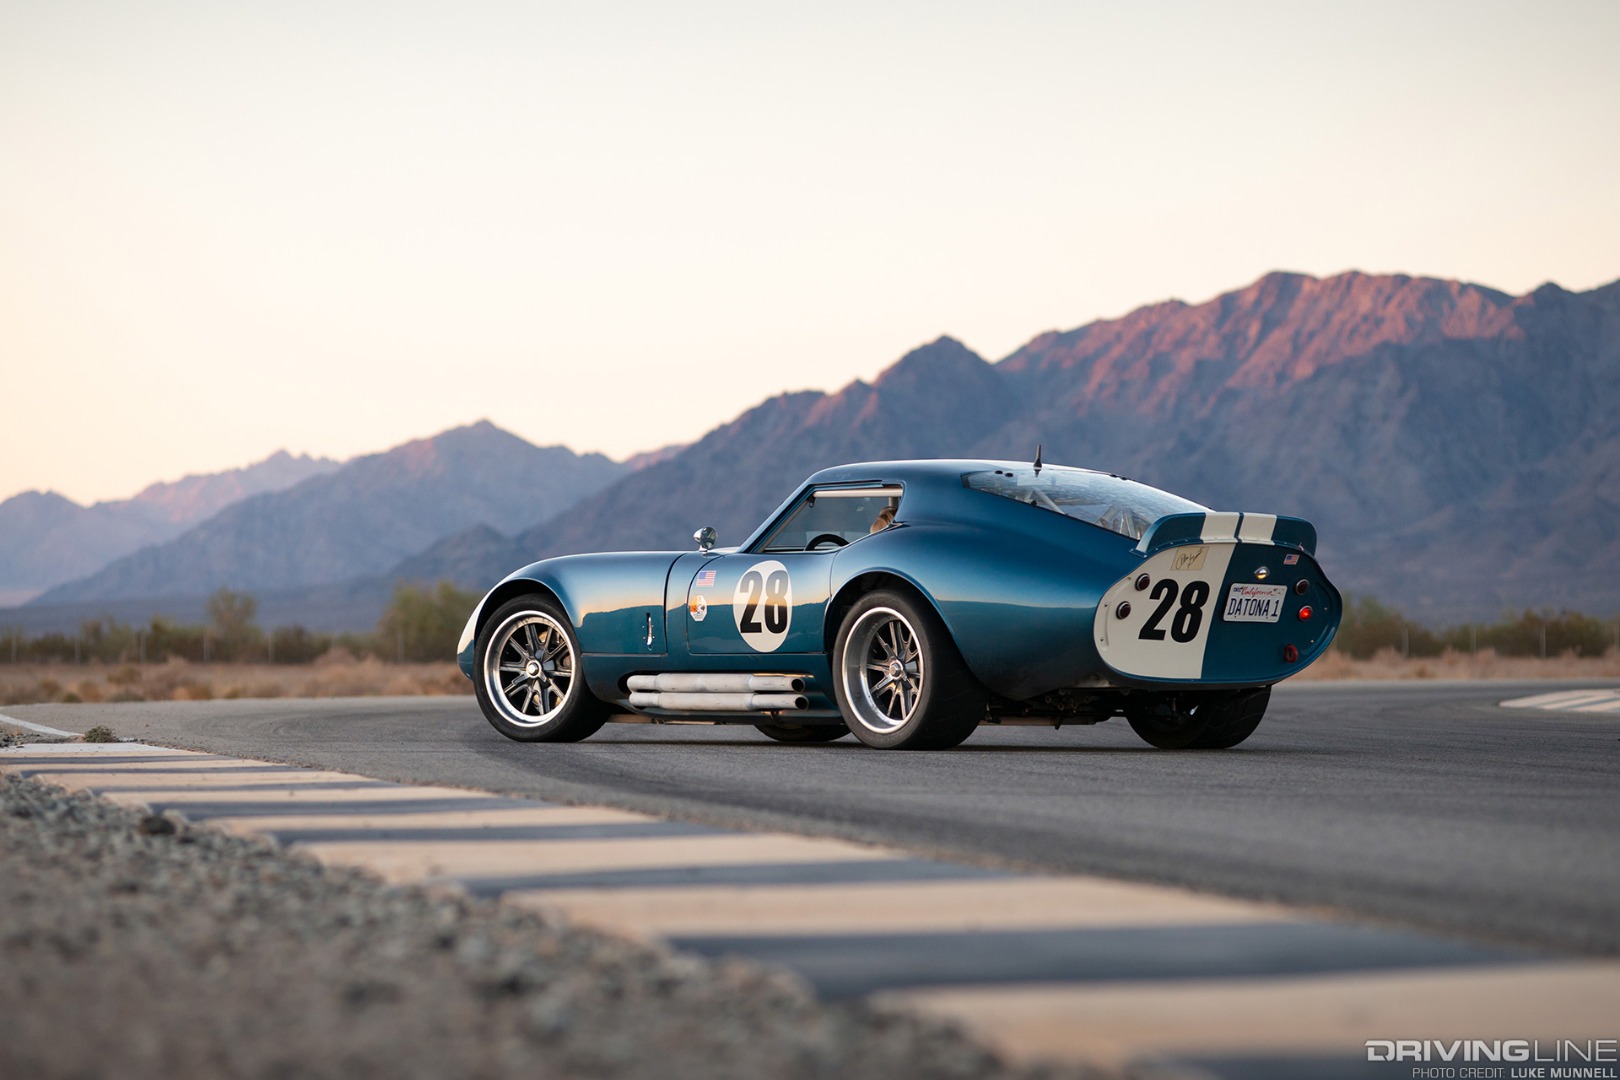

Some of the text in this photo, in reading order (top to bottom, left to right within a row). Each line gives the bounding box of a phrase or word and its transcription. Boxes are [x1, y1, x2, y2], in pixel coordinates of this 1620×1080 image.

[740, 570, 789, 634] 28
[1138, 578, 1210, 643] 28
[1227, 598, 1280, 617] DATONA 1
